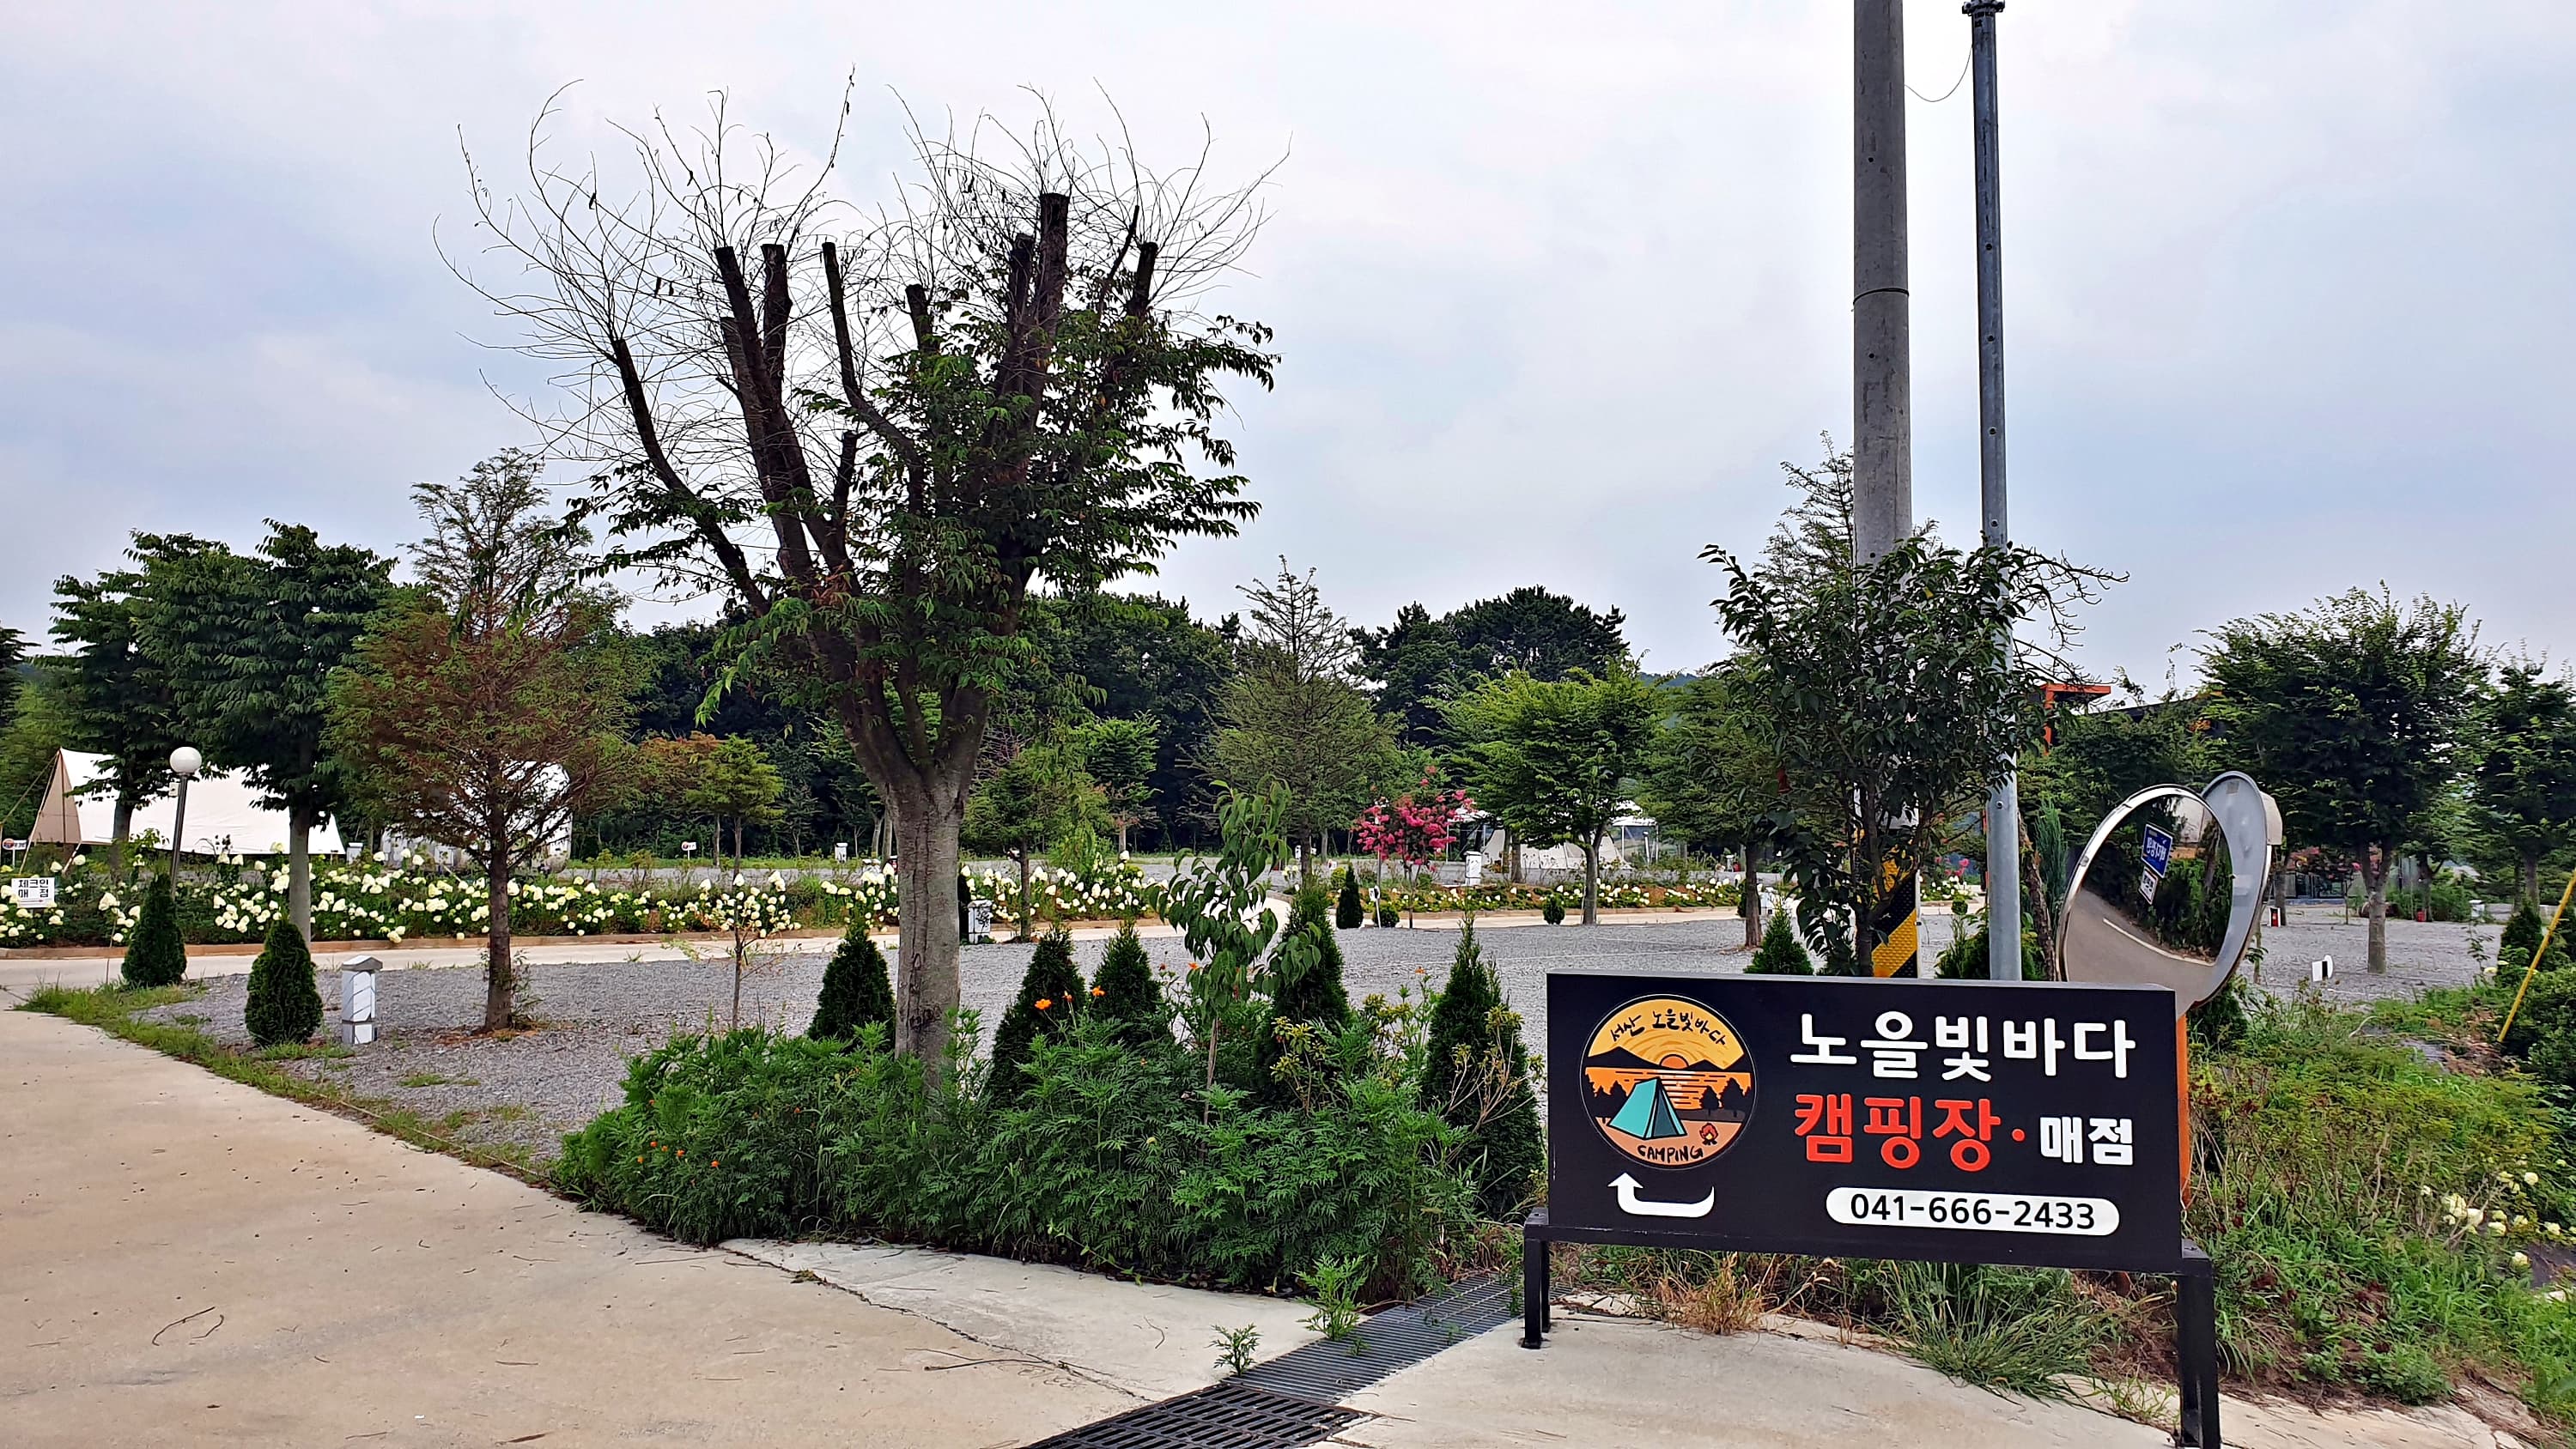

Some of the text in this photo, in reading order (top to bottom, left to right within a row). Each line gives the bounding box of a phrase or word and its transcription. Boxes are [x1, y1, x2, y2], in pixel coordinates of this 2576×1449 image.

[18, 879, 49, 888] 체크인
[1610, 1009, 1726, 1046] 서산 노을빛바다
[1790, 1010, 2136, 1082] 노을빛바다
[1637, 1144, 1704, 1163] CAMPING
[2040, 1116, 2133, 1166] 매점
[1850, 1193, 2095, 1230] 041-666-2433
